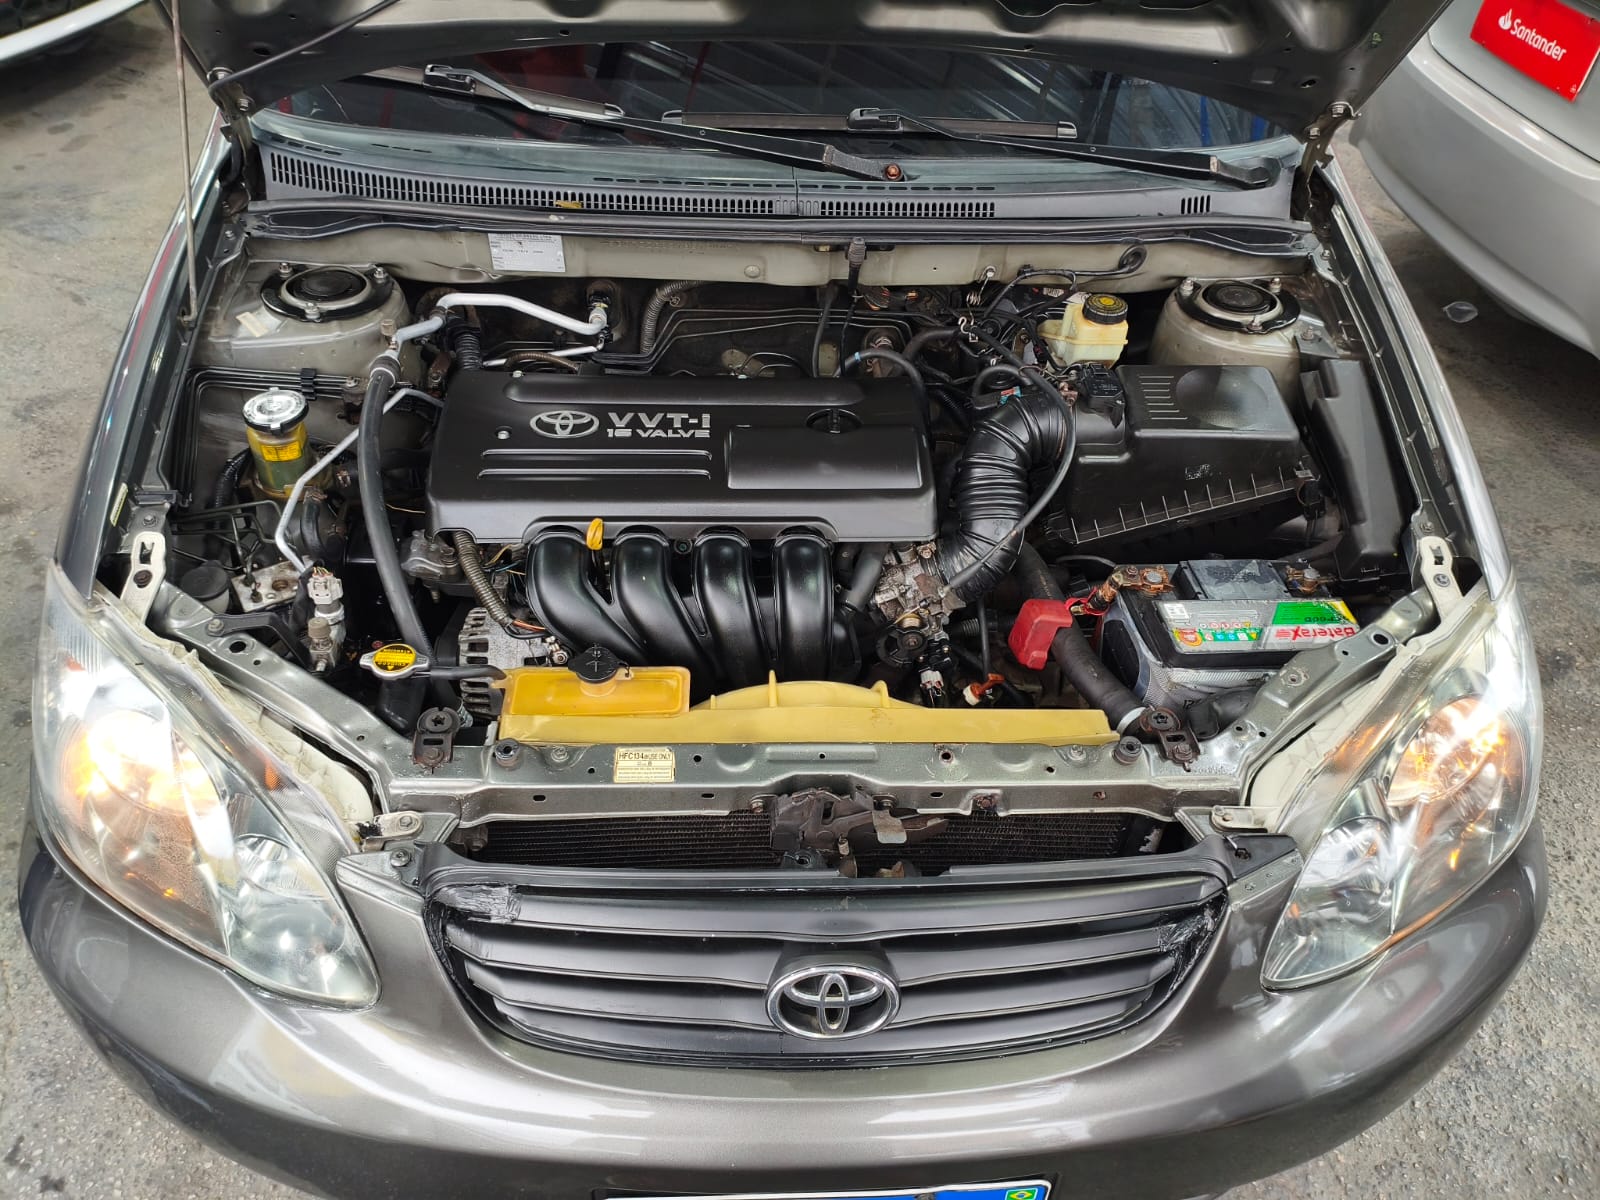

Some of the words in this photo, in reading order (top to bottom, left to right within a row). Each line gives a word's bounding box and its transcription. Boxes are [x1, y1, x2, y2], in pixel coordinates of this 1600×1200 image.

[1510, 18, 1567, 61] Santander
[606, 428, 633, 438] 16
[635, 429, 711, 438] VALVE
